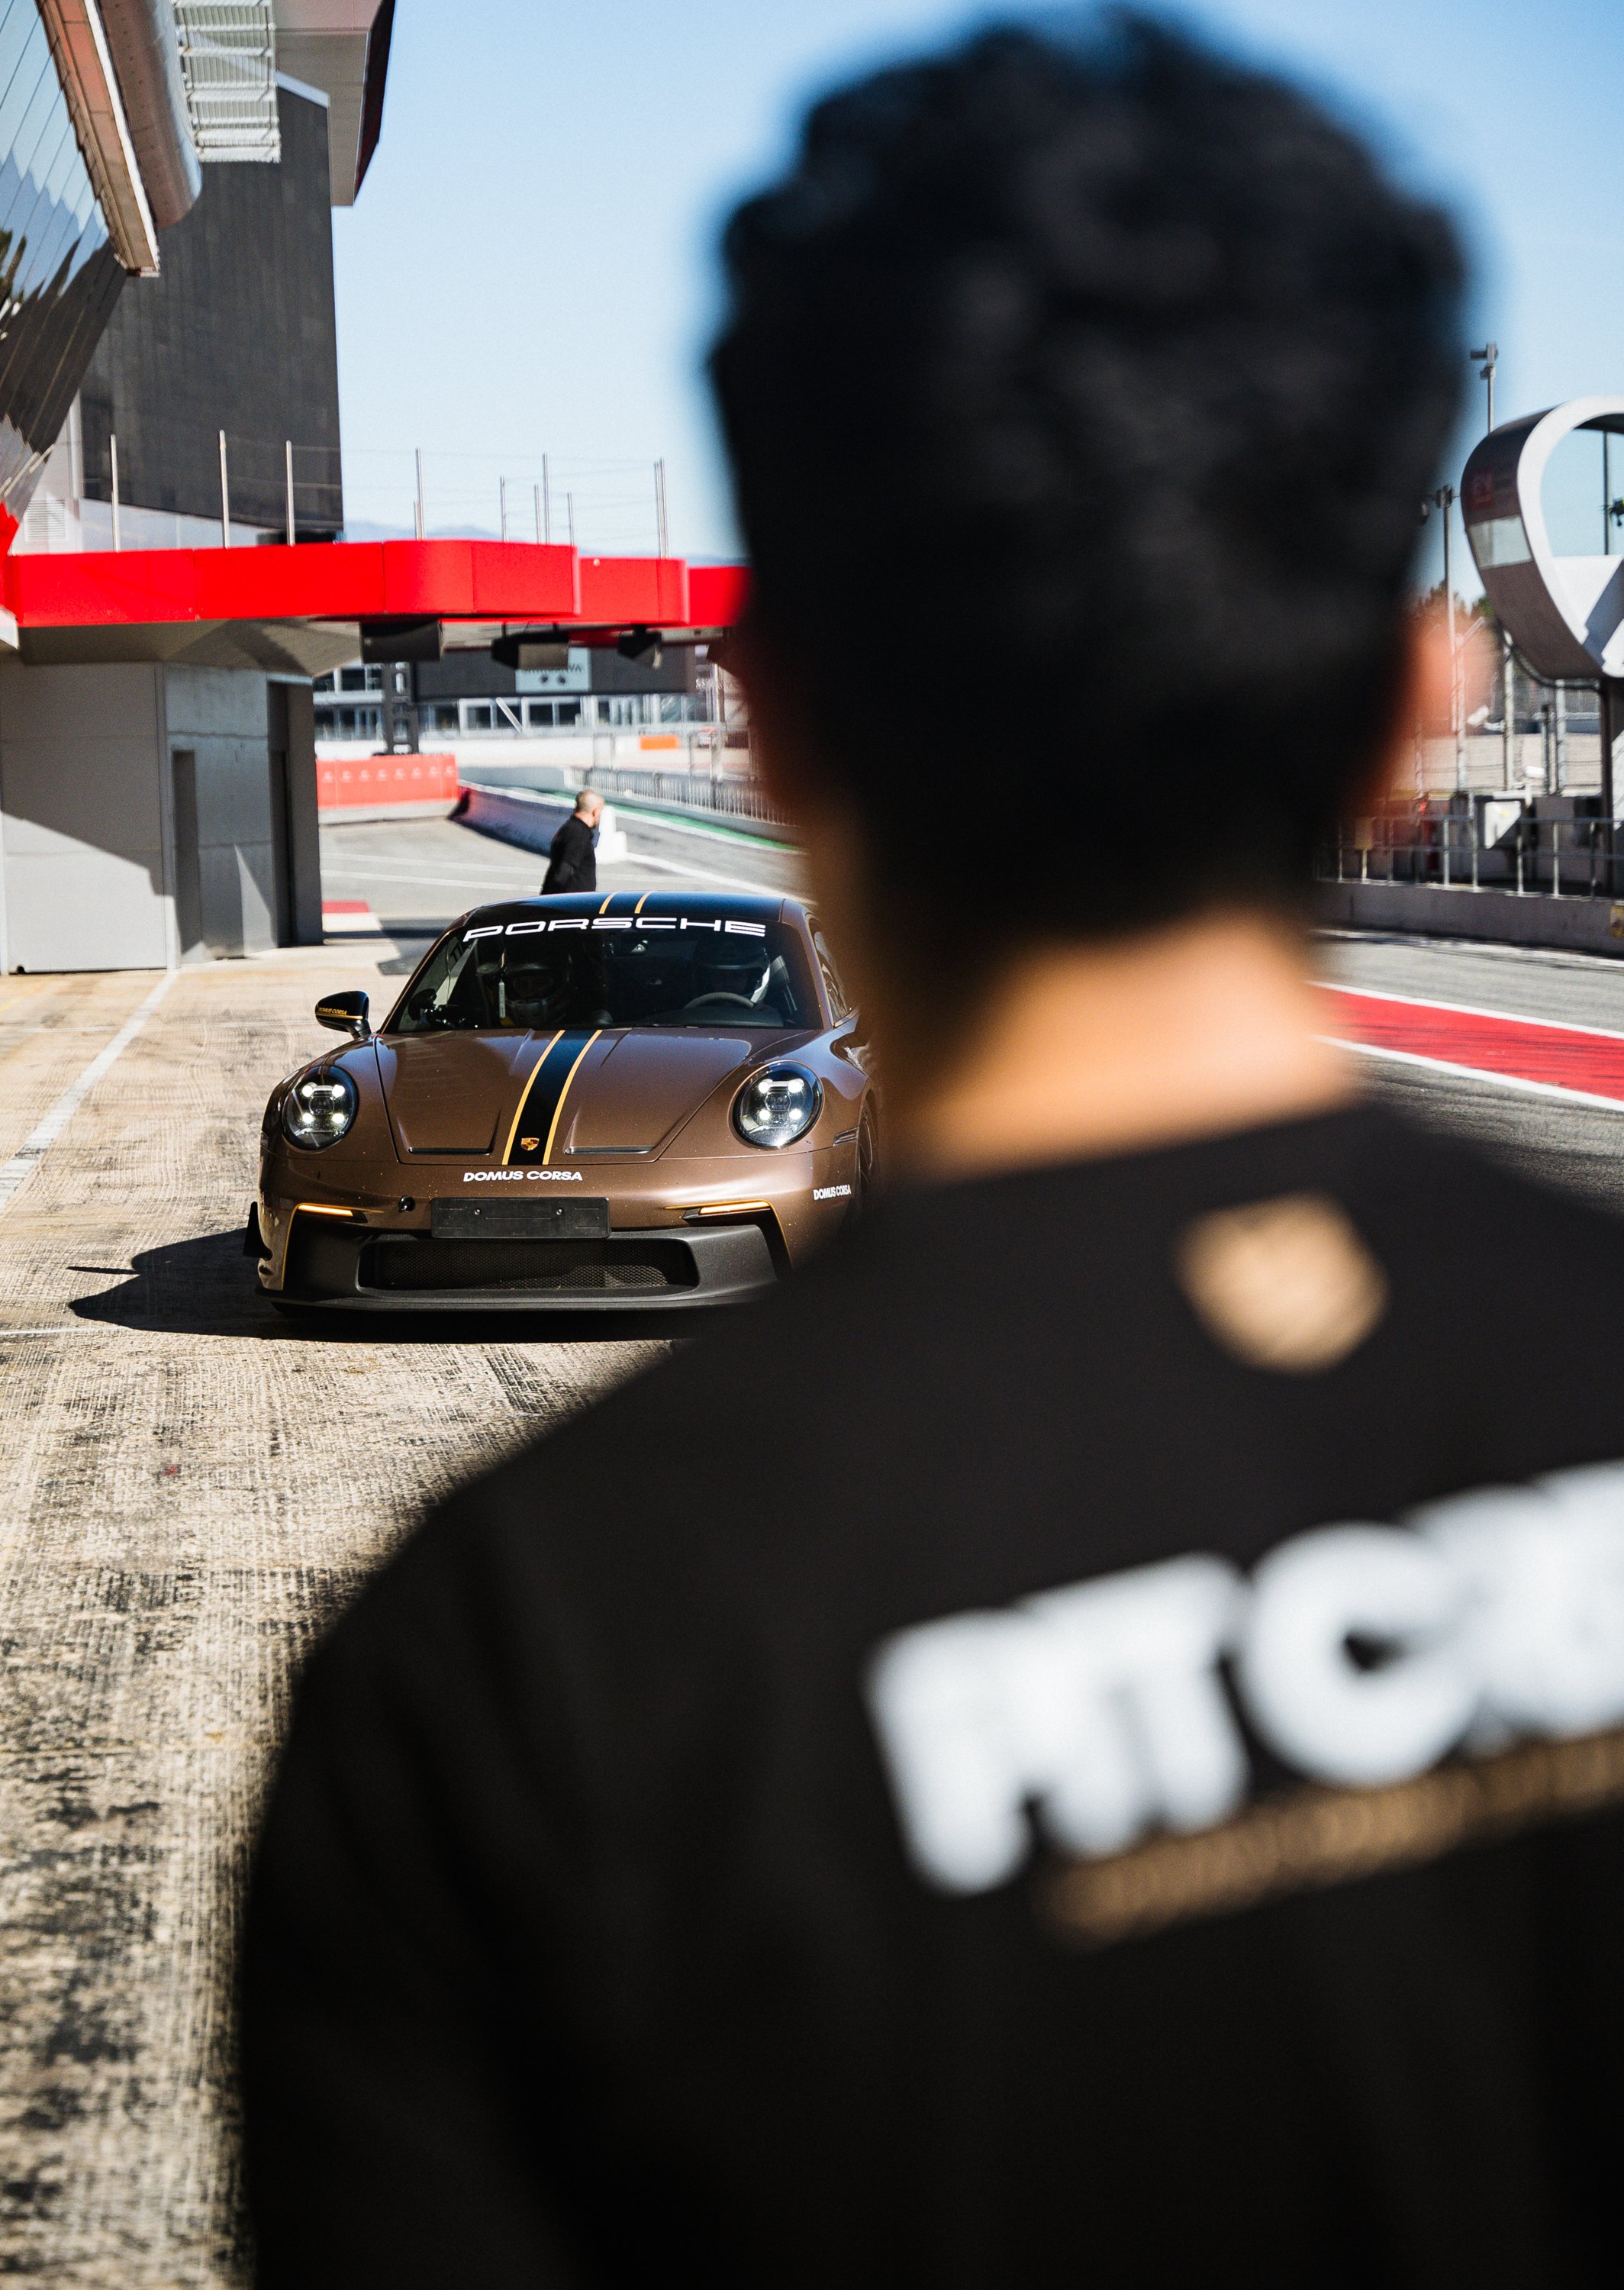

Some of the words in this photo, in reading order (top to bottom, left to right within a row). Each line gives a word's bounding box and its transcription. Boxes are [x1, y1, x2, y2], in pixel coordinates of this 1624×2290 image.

[462, 918, 765, 942] PORSCHE
[463, 1170, 524, 1182] DOMUS
[527, 1170, 583, 1181] CORSA
[814, 1186, 836, 1200] DOMUS
[836, 1185, 852, 1196] CORSA
